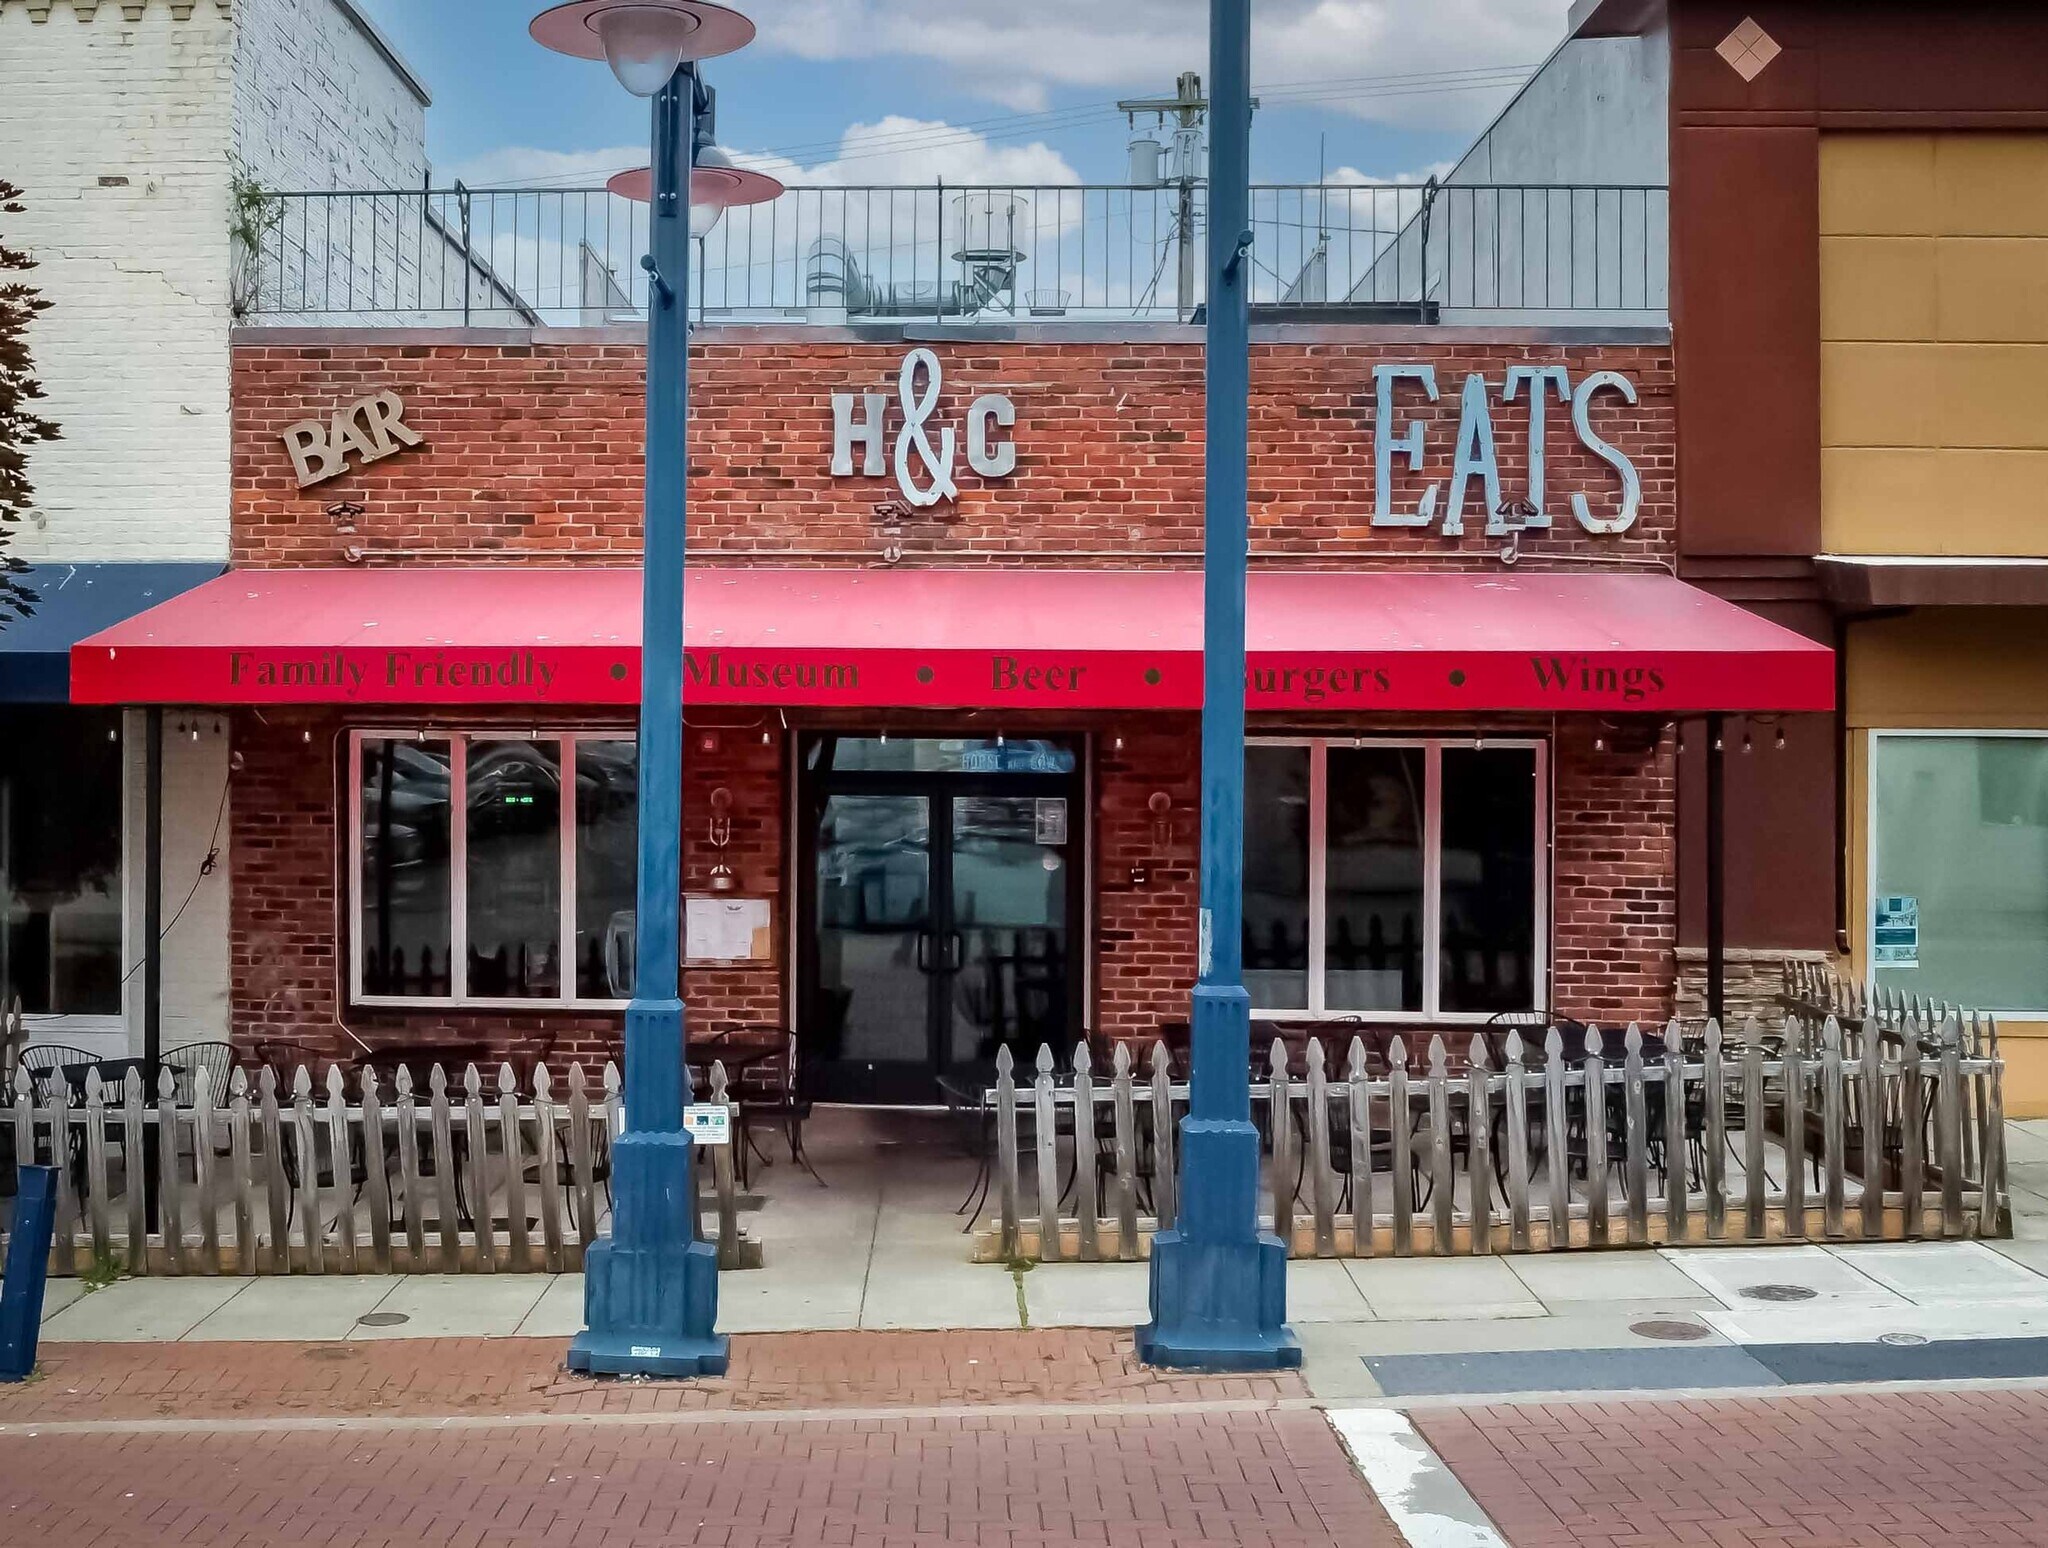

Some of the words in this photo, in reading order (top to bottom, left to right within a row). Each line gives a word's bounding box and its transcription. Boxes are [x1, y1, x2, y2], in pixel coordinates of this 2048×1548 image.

[281, 389, 424, 488] BAR
[1371, 364, 1641, 536] EATS
[230, 651, 367, 696] Family
[385, 651, 558, 696] Friendly
[683, 651, 861, 688] Museum
[991, 656, 1088, 691] Beer
[1245, 666, 1391, 703] urgers
[1530, 656, 1665, 702] Wings
